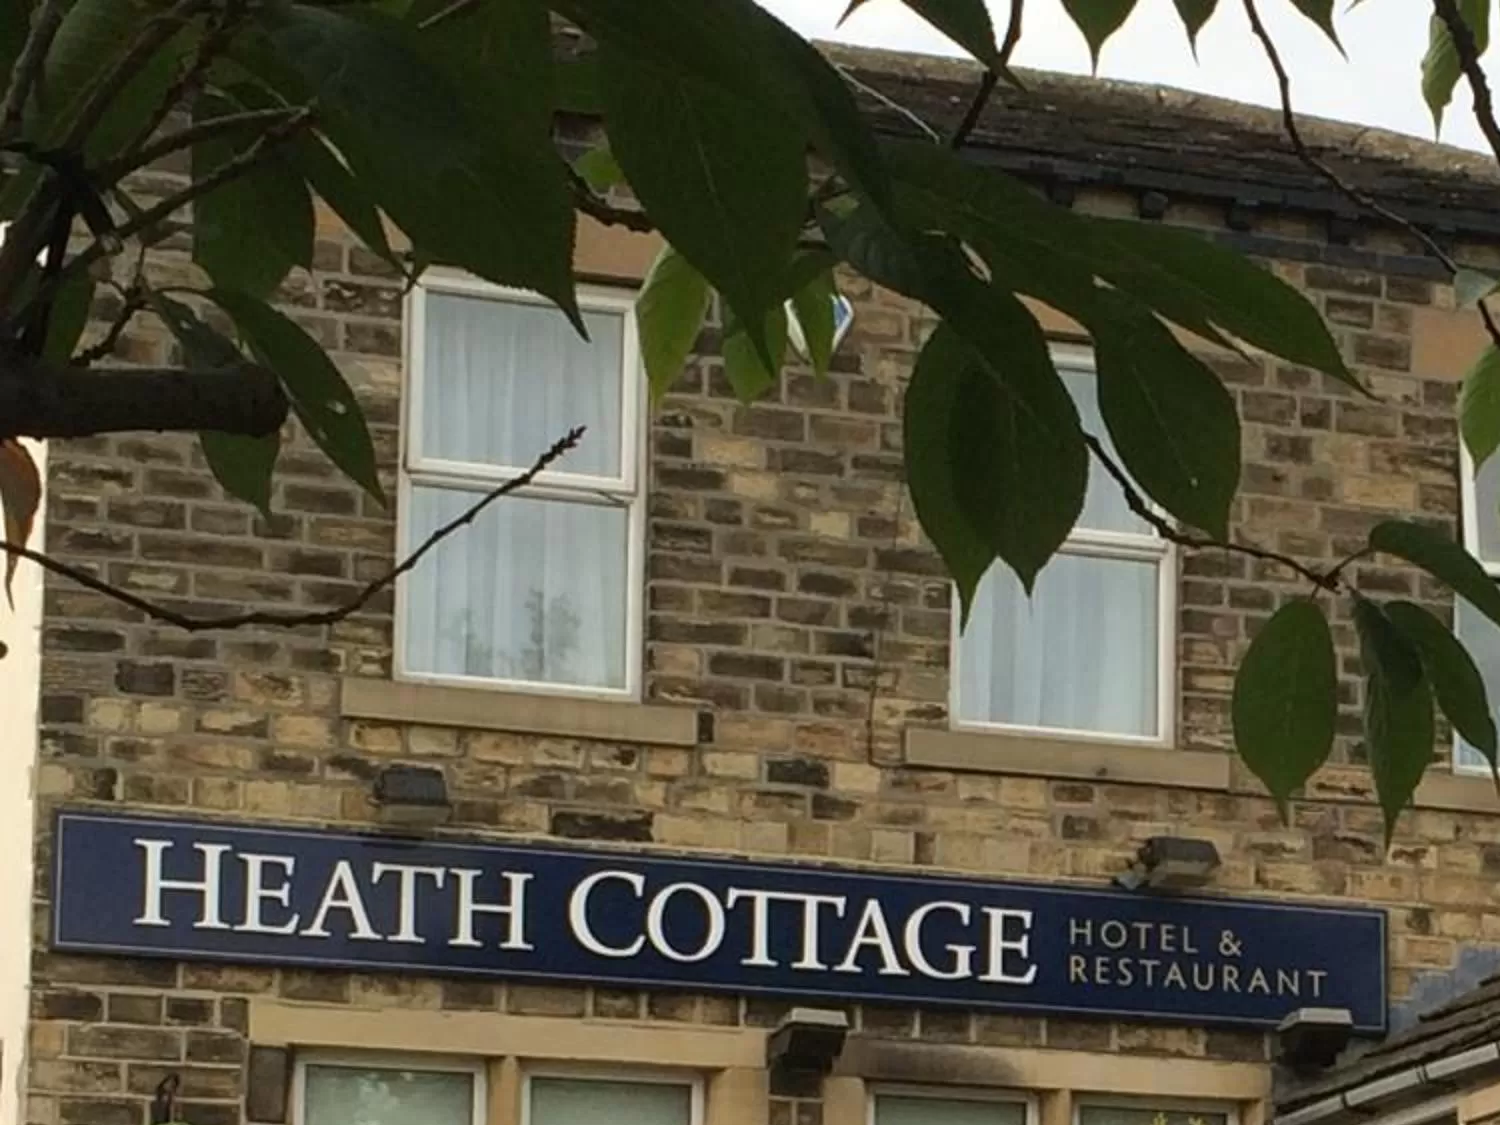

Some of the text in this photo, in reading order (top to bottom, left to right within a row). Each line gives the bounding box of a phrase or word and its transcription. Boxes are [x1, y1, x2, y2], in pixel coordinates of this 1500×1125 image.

[133, 837, 1038, 985] HEATH COTTAGE
[1069, 918, 1243, 958] HOTEL &
[1069, 955, 1328, 998] RESTAURANT
